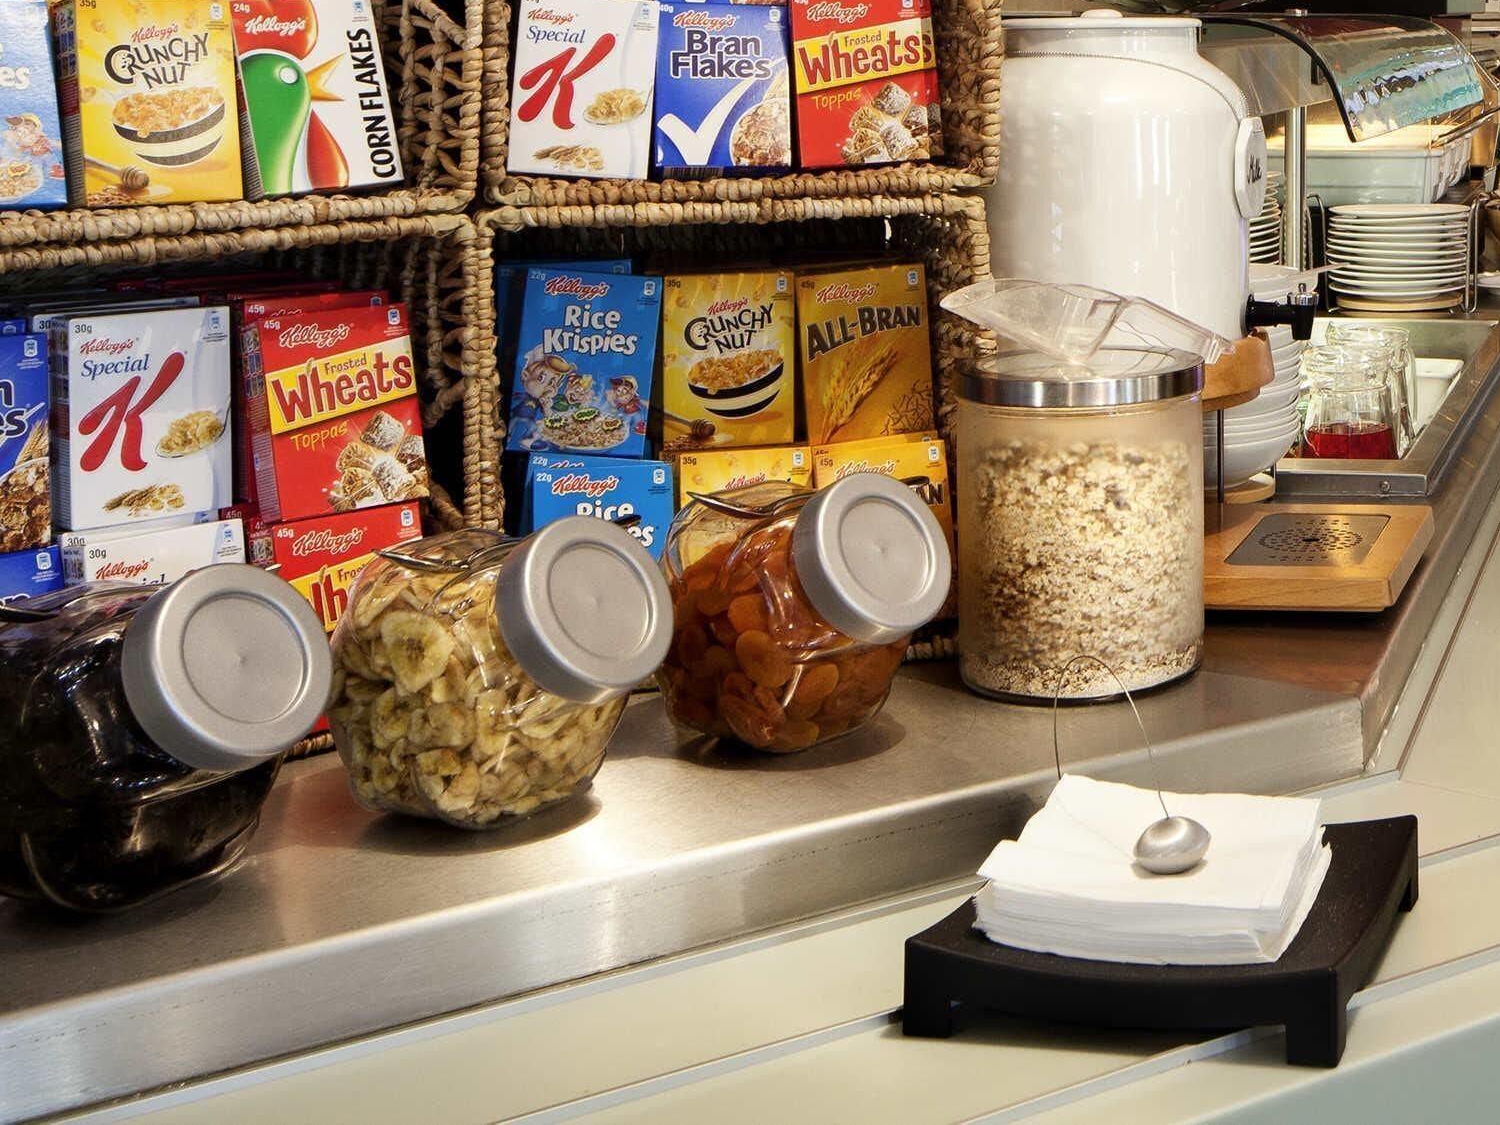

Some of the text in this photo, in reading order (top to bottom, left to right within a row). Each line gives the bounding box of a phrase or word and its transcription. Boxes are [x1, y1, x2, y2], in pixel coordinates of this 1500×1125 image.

[233, 3, 250, 13] 24g
[527, 8, 574, 25] Kellogg's
[807, 2, 868, 23] Kellogg's
[244, 15, 307, 36] Kellogg's
[673, 10, 735, 31] Kellogg's
[131, 23, 178, 43] Kellogg's
[526, 26, 585, 44] Special
[686, 29, 761, 57] Bran
[844, 30, 882, 46] Frosted
[104, 33, 209, 84] CRUNCHY
[671, 51, 772, 79] Flakes
[798, 30, 921, 86] Wheats
[142, 61, 191, 89] NUT
[517, 33, 616, 129] K
[346, 28, 397, 177] CORN FLAKES
[544, 275, 610, 300] Kellogg's
[667, 279, 681, 288] 35g
[816, 282, 876, 304] Kellogg's
[248, 305, 265, 315] 45g
[565, 304, 622, 329] Rice
[708, 297, 749, 315] Kellogg's
[39, 320, 50, 329] 30
[74, 324, 92, 334] 30g
[263, 320, 281, 331] 45g
[684, 303, 774, 350] CRUNCHY
[807, 306, 920, 363] ALL-BRAN
[279, 323, 349, 348] Kellogg's
[543, 328, 638, 355] Krispies
[714, 329, 758, 354] NUT
[80, 338, 135, 355] Kellogg's
[81, 354, 150, 380] Special
[324, 353, 367, 375] Frosted
[271, 350, 412, 424] Wheats
[78, 351, 185, 472] K
[532, 456, 547, 466] 22g
[682, 457, 697, 465] 35g
[536, 472, 552, 482] 22g
[552, 474, 619, 497] Kellogg's
[276, 528, 295, 539] 45g
[292, 528, 364, 556] Kellogg's
[89, 548, 107, 559] 30g
[96, 559, 150, 579] Kellogg's
